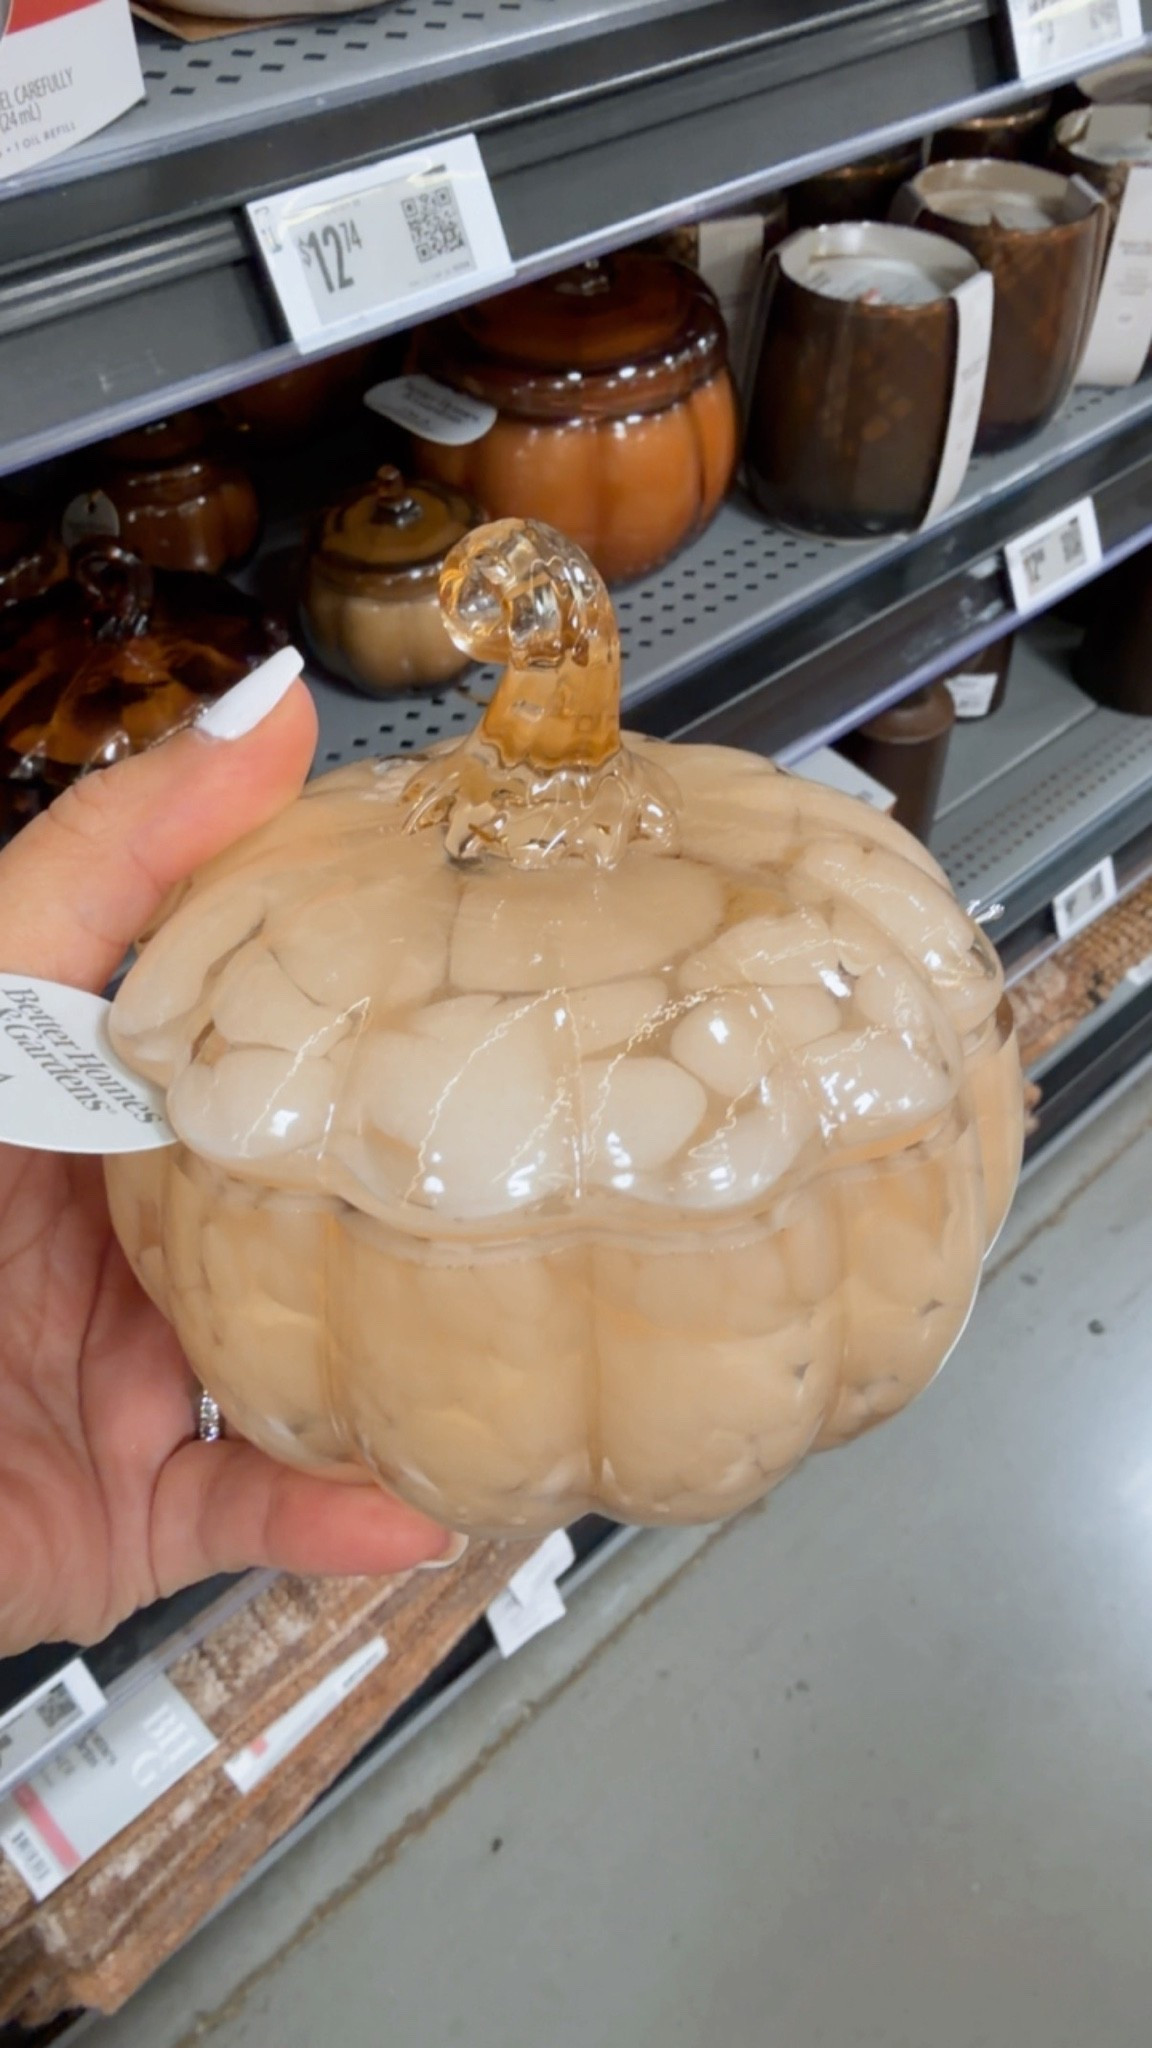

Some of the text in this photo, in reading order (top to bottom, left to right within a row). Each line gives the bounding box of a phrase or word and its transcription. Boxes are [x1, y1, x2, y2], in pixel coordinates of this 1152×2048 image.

[13, 67, 73, 105] CAREFULLY
[2, 988, 163, 1123] Better Homes
